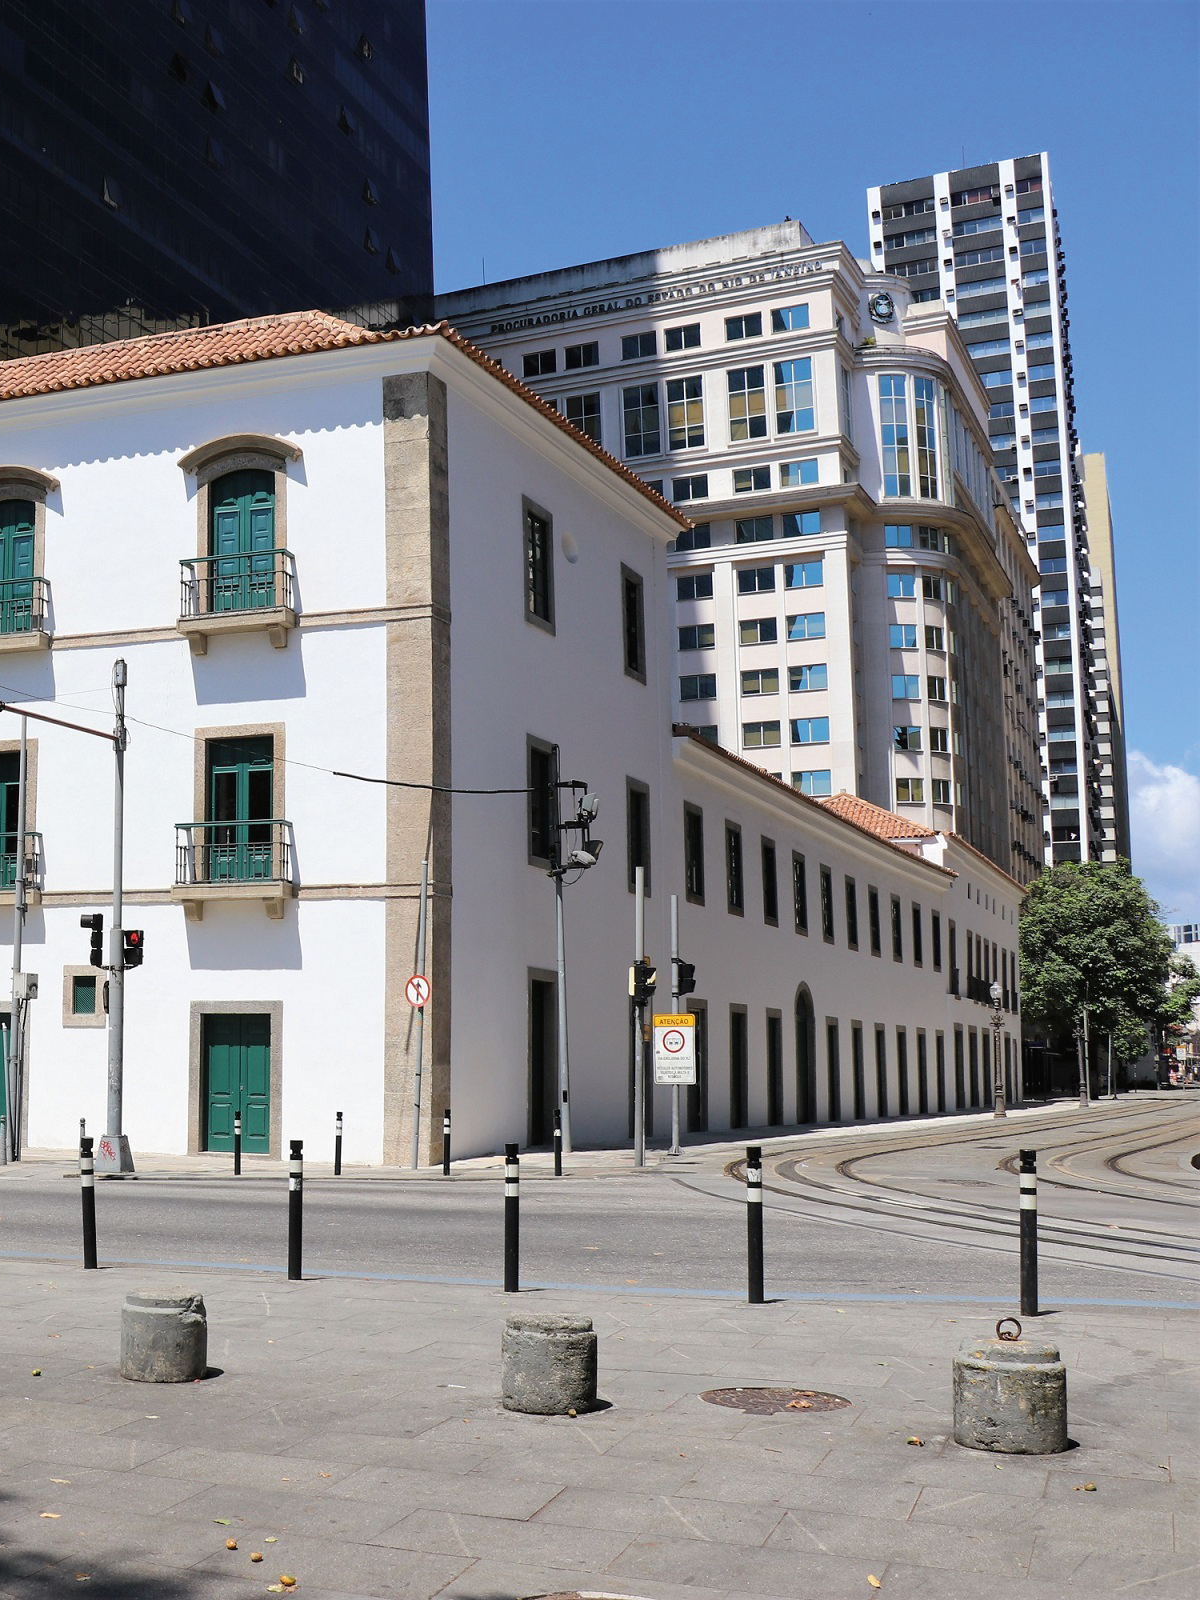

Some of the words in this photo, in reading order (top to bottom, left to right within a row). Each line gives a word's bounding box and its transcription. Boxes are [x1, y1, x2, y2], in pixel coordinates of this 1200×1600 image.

[491, 309, 579, 333] PROCURADORIA
[583, 301, 621, 316] GERAL
[625, 296, 642, 307] DO
[647, 286, 693, 304] ESTADO
[699, 282, 716, 294] DO
[721, 276, 743, 290] RIO
[749, 272, 766, 284] DE
[770, 260, 823, 280] JANEIRO
[659, 1018, 689, 1026] ATENÇÃO
